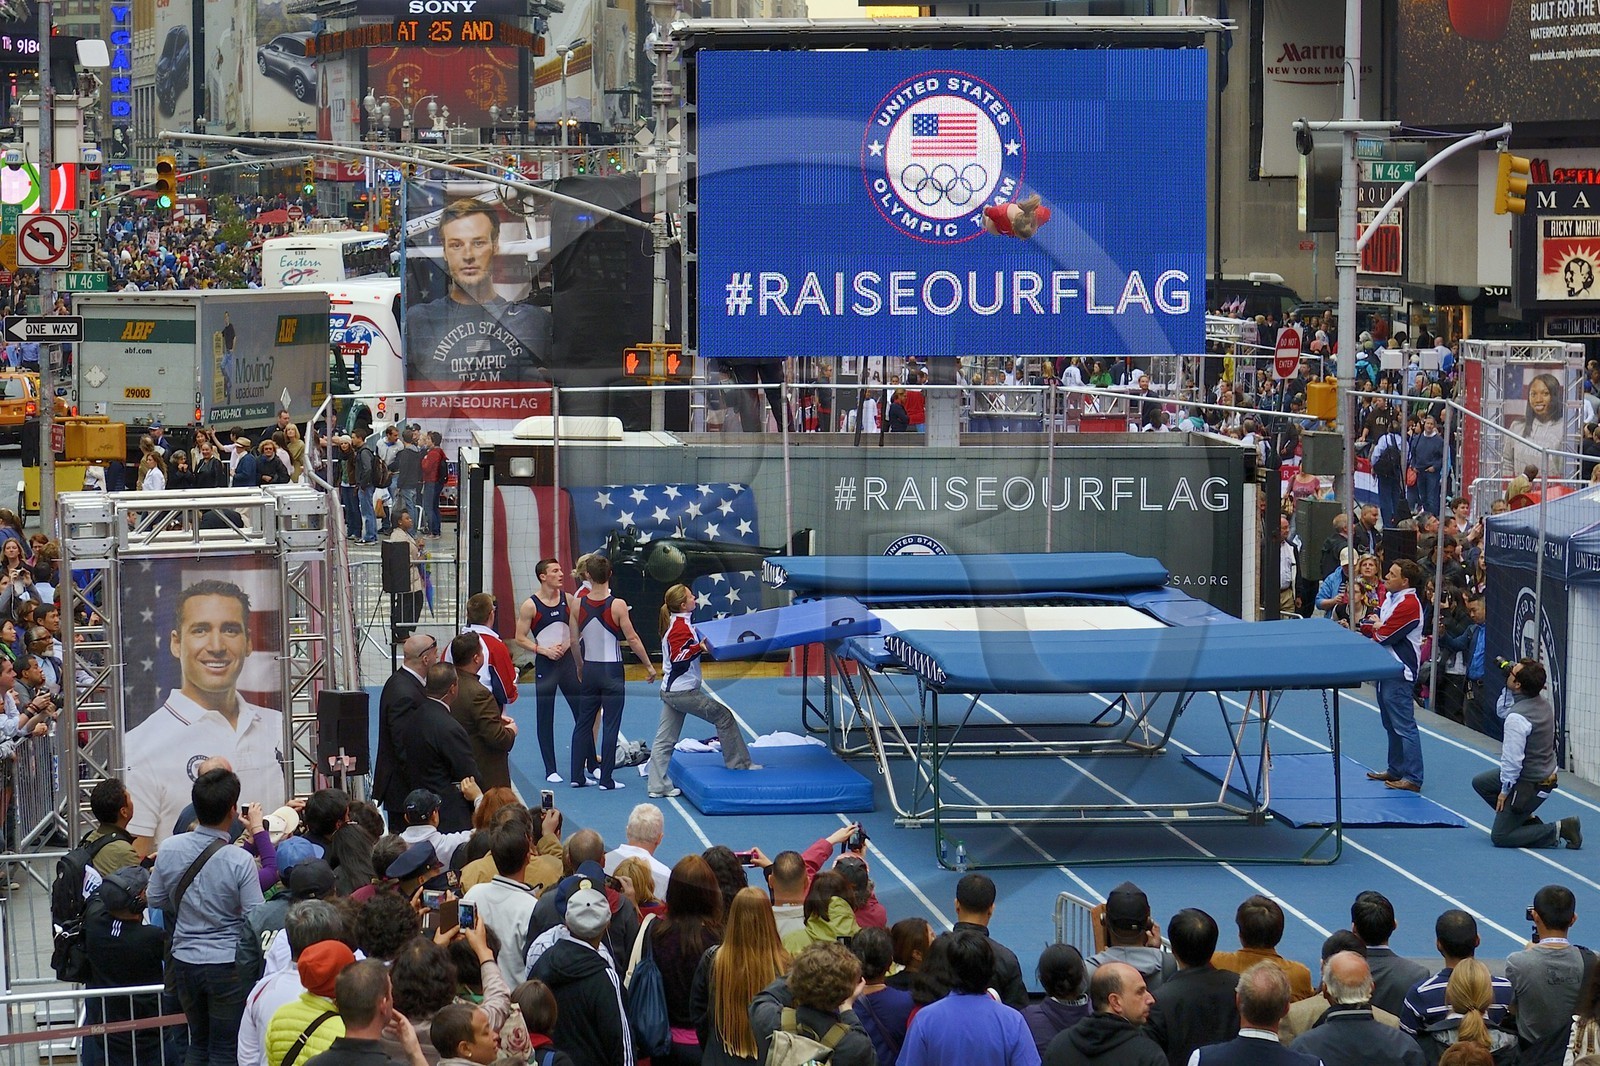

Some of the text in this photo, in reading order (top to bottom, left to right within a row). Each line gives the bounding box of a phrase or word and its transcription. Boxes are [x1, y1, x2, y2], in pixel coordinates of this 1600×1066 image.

[408, 0, 477, 14] SONY
[1530, 0, 1596, 21] BUILT FOR THE
[397, 21, 418, 41] AT
[461, 21, 494, 41] AND
[1277, 42, 1346, 63] Marrio
[1267, 65, 1373, 75] NEW YORK MAIS
[877, 77, 1011, 127] UNITED STATES
[1375, 164, 1413, 180] W 46 ST
[873, 177, 1017, 236] OLYMPIC TAM
[1550, 220, 1573, 237] RICKY
[280, 254, 322, 268] Eastern
[69, 274, 105, 289] W 46 ST
[725, 269, 1192, 318] #RAISEOURFLAG
[25, 324, 75, 335] ONE WAY
[120, 321, 156, 340] ABF
[278, 318, 299, 343] ABF
[432, 321, 523, 362] UNITED STATES
[1280, 337, 1298, 347] DO NOT
[235, 356, 275, 388] Moving?
[450, 354, 507, 373] OLYMPIC
[1278, 360, 1294, 369] ENTER
[458, 370, 501, 382] TEAM
[125, 387, 151, 399] 29003
[421, 396, 538, 409] #RAISEOURFLAG
[834, 475, 1230, 512] #RAISEOURFLAG
[1489, 531, 1507, 549] UNITED
[1508, 533, 1525, 550] STATES
[1549, 541, 1563, 560] TEAM
